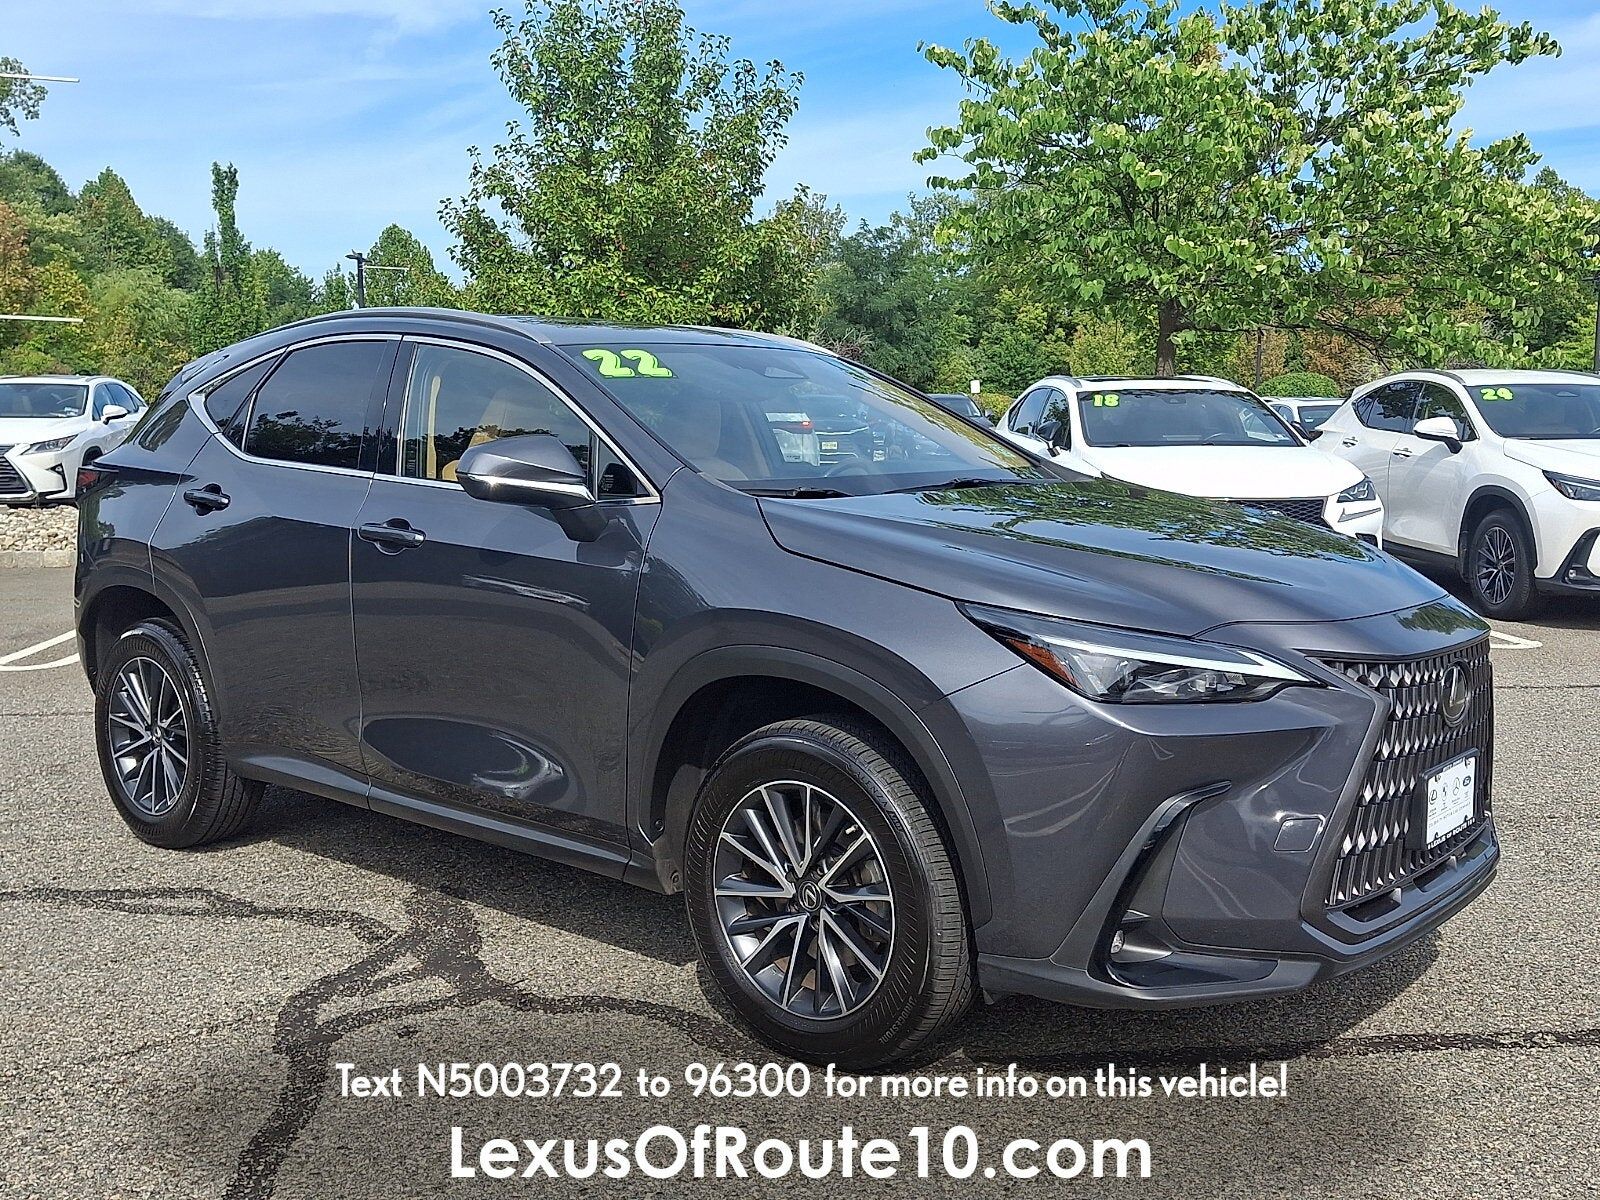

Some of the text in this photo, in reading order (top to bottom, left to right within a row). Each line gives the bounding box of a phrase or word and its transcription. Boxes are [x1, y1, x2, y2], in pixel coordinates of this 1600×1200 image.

[582, 348, 674, 378] 22
[1093, 394, 1119, 407] 18
[1480, 387, 1513, 400] 24
[853, 771, 888, 808] ALENZA
